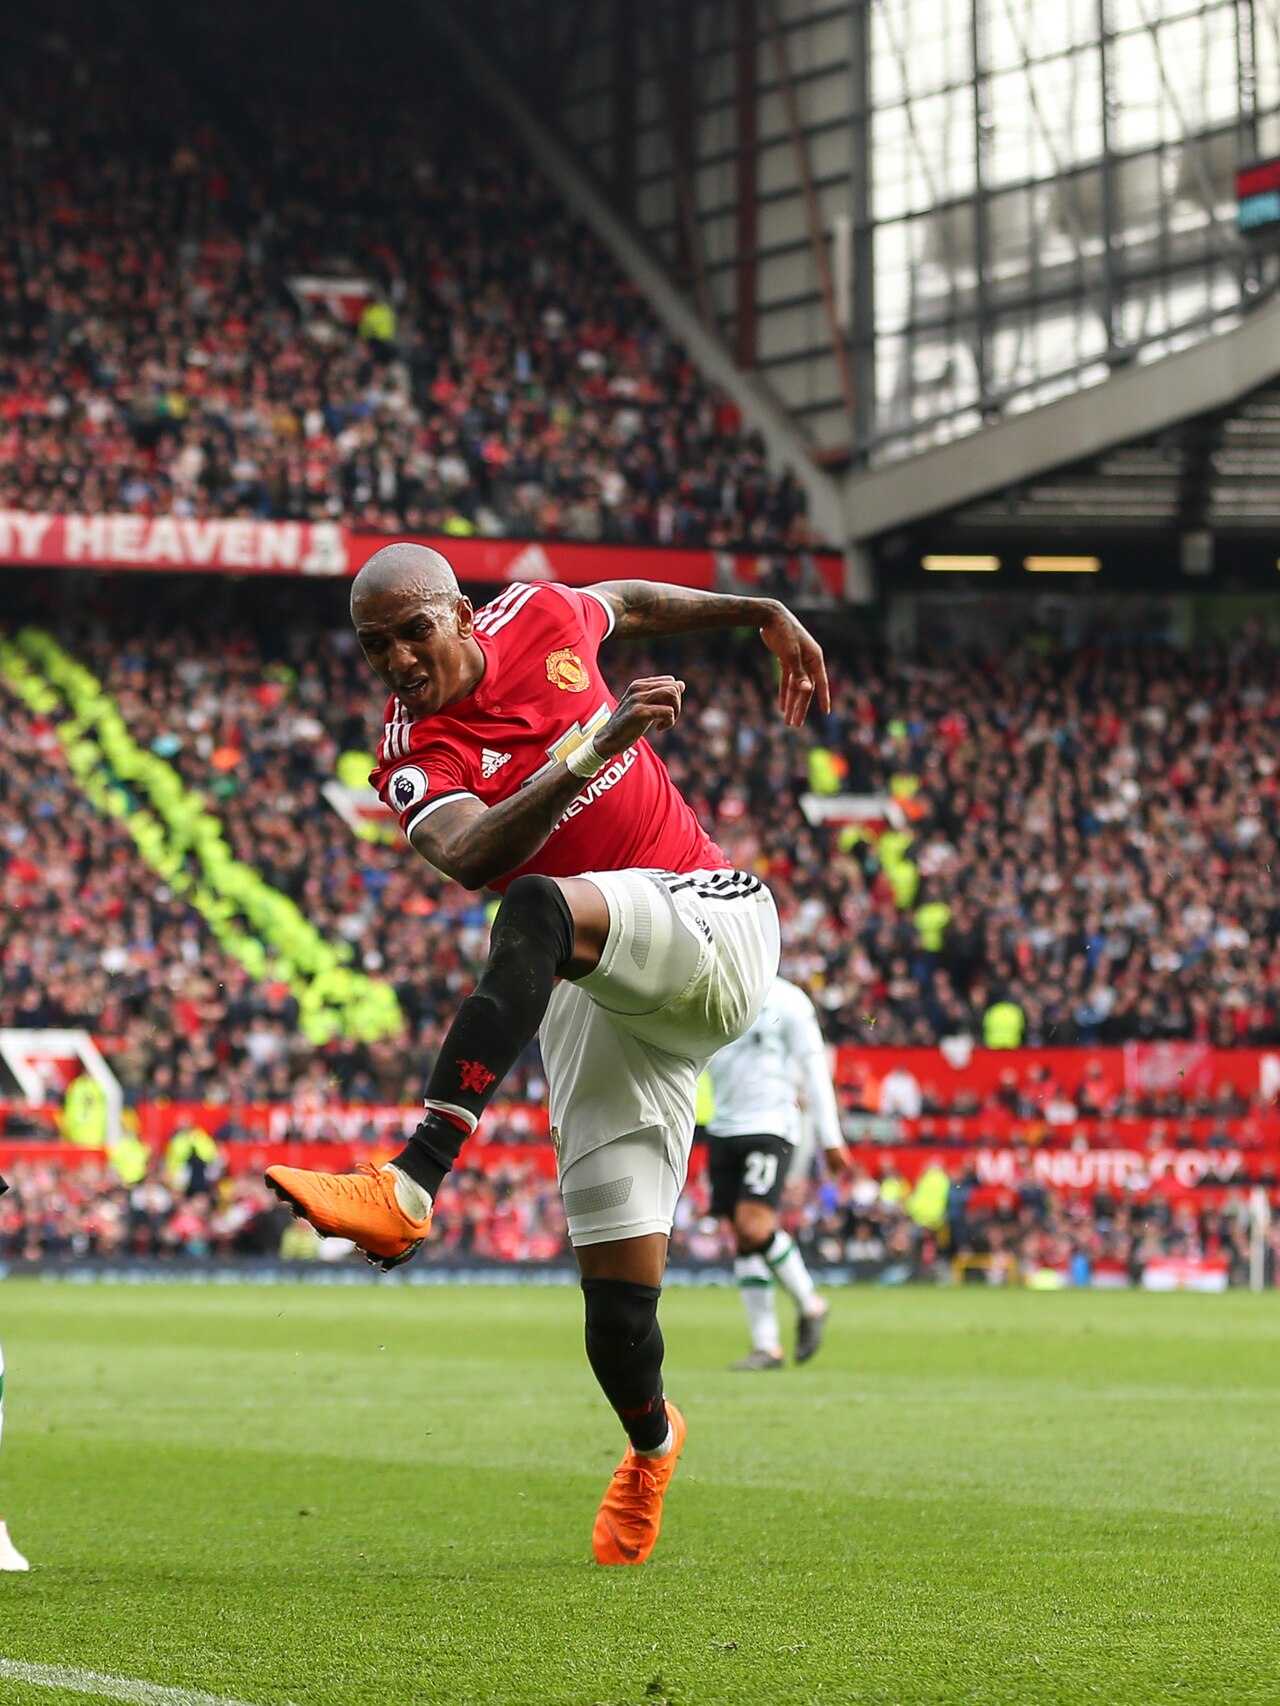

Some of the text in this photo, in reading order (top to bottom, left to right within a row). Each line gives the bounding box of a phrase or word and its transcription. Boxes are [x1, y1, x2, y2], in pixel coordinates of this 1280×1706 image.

[64, 513, 300, 568] HEAVEN
[482, 752, 512, 778] adidas
[555, 746, 639, 831] EVROLE
